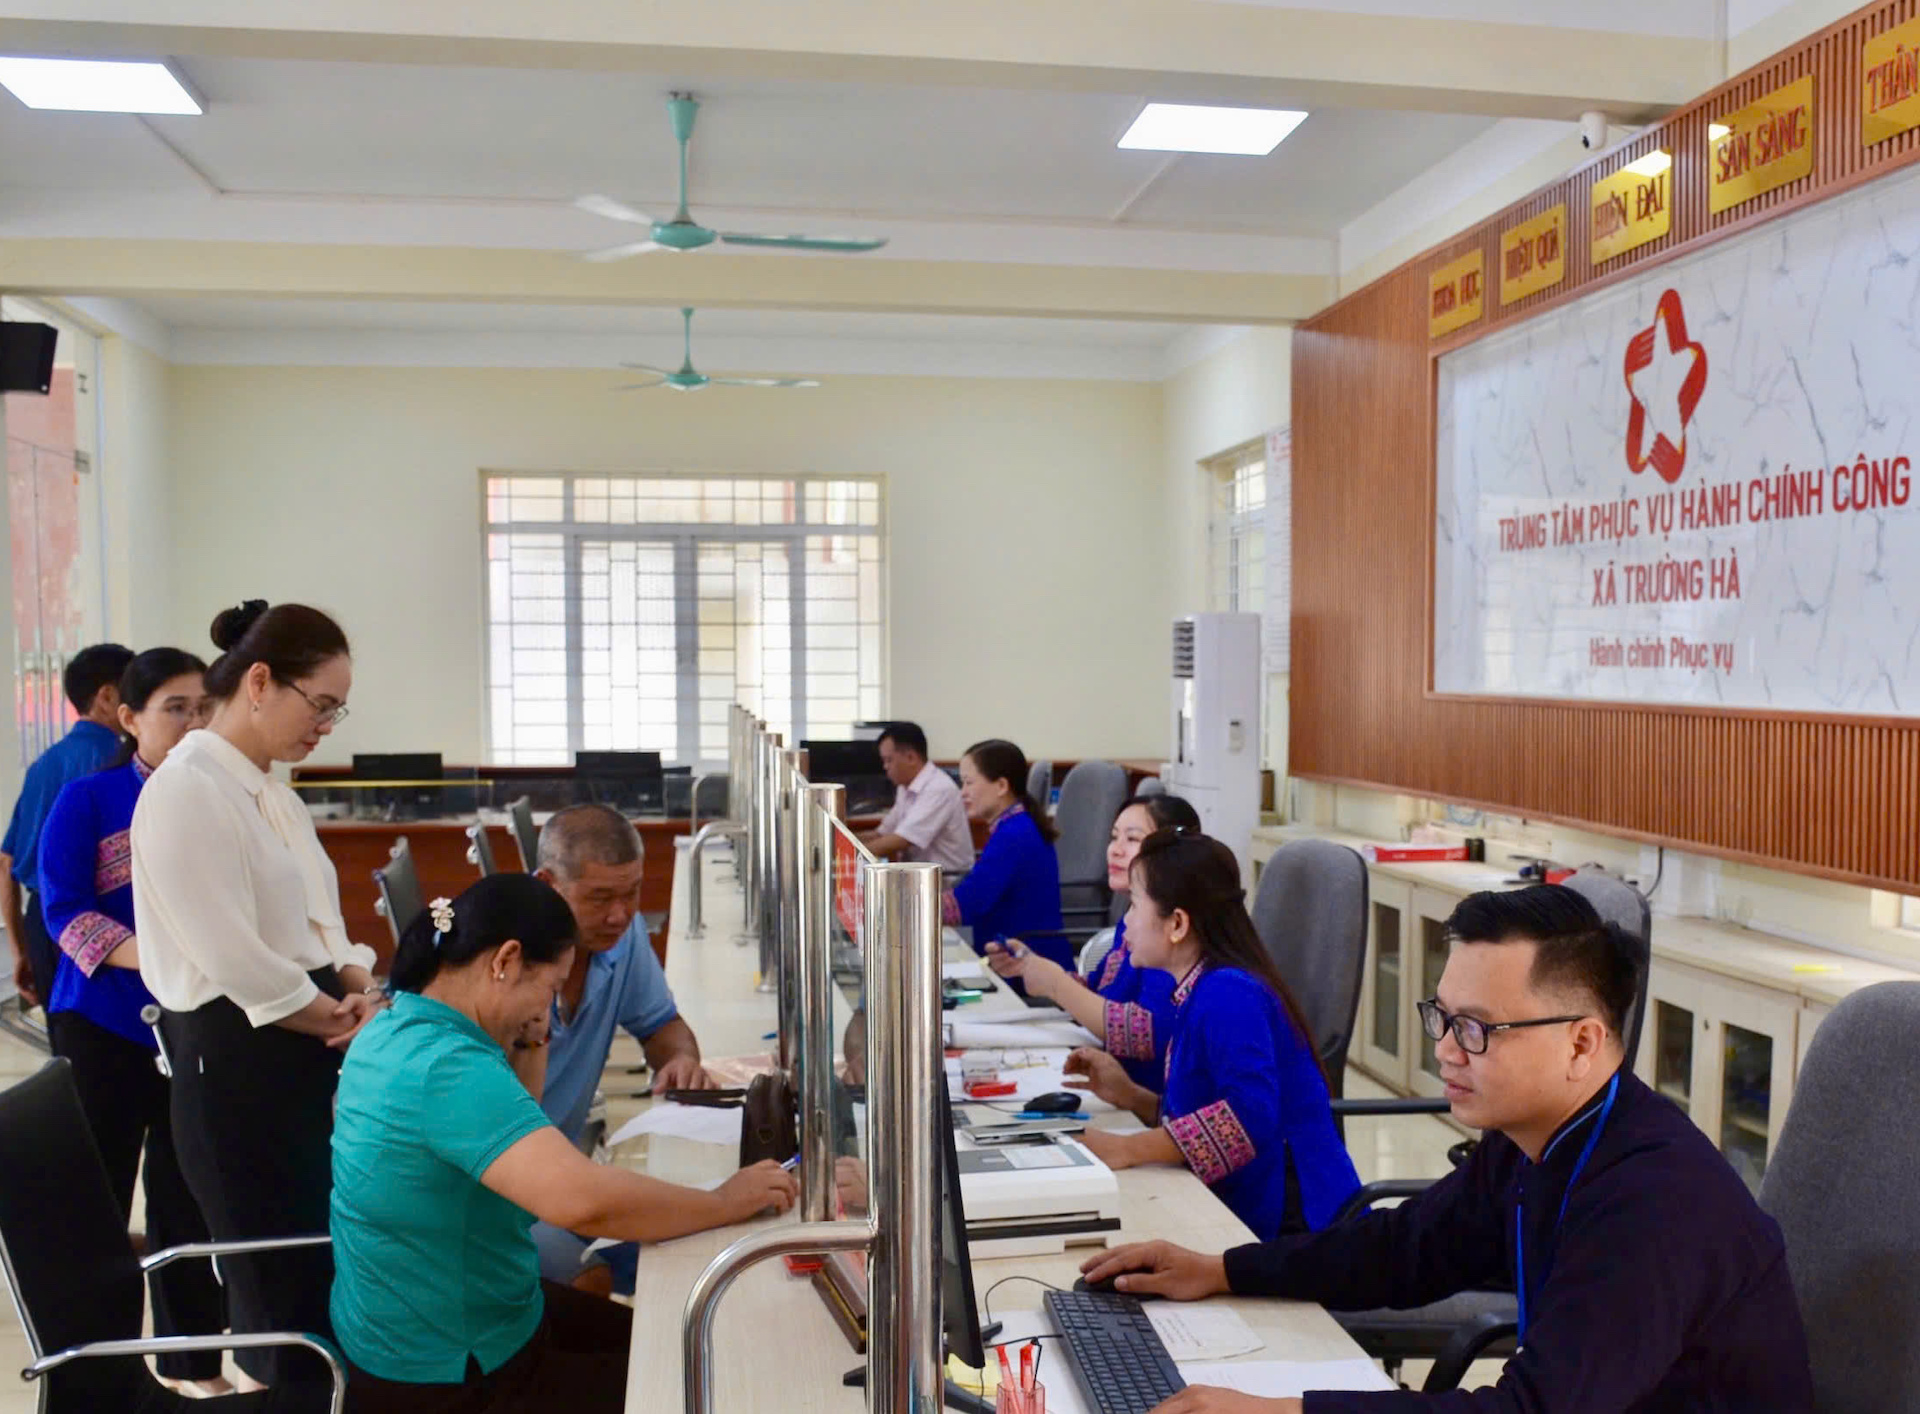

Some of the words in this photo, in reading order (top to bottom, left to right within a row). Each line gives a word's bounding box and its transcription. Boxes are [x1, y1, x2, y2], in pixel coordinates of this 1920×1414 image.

[1755, 105, 1806, 166] SÀNG
[1636, 173, 1664, 222] ĐẠI
[1498, 513, 1547, 551] TRUNG
[1551, 502, 1585, 547] TÂM
[1589, 498, 1639, 547] PHỤC
[1647, 492, 1674, 542] VỤ
[1680, 477, 1741, 530] HÀNH
[1748, 463, 1824, 523] CHÍNH
[1833, 452, 1911, 513] CÔNG
[1592, 559, 1617, 607] XÃ
[1624, 551, 1704, 604] TRƯỜNG
[1710, 546, 1741, 600] HÀ
[1589, 637, 1624, 667] Hành
[1627, 637, 1665, 668] chính
[1669, 636, 1709, 676] Phục
[1712, 642, 1734, 676] vụ
